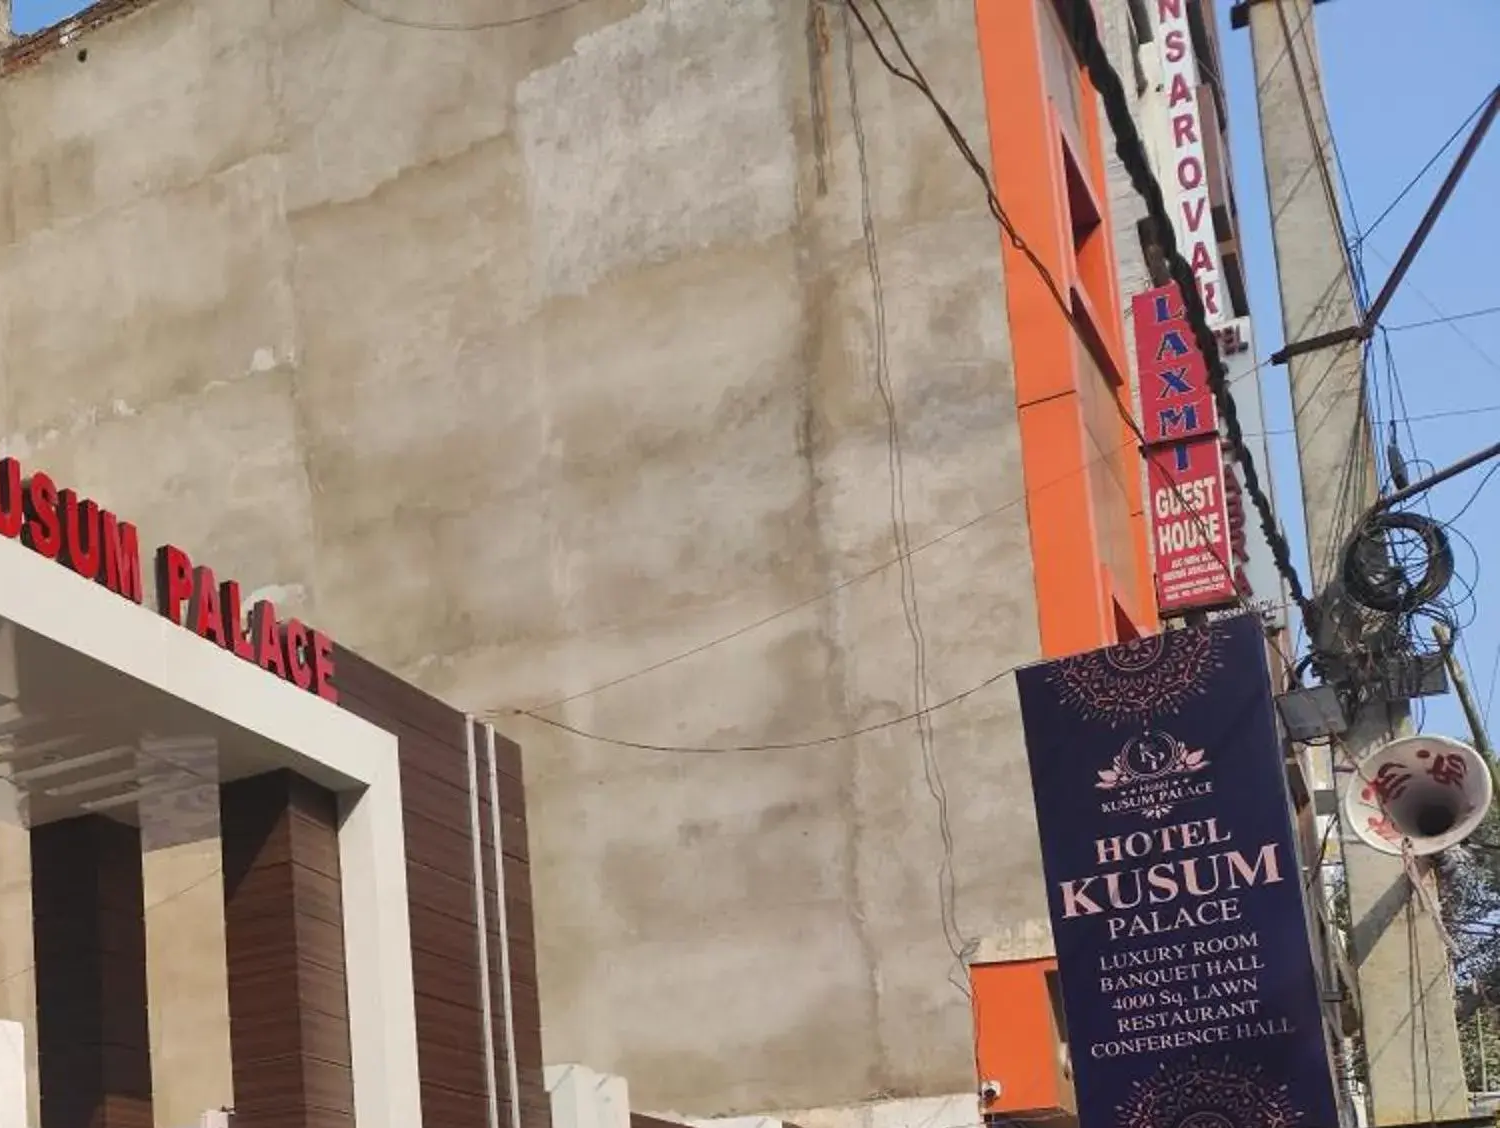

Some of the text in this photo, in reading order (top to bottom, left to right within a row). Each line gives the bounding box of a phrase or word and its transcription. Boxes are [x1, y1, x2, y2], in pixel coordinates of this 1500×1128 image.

[1155, 475, 1216, 519] GUEST
[1158, 512, 1222, 556] HOUSE
[156, 543, 342, 704] PALACE
[1100, 781, 1213, 814] KUSUM PALACE
[1095, 817, 1231, 865] HOTEL
[1058, 843, 1284, 921] KUSUM
[1107, 898, 1242, 940] PALACE
[1100, 931, 1259, 971] LUXURY ROOM
[1100, 953, 1265, 992] BANQUET HALL
[1111, 989, 1155, 1011] 4000
[1192, 977, 1258, 1001] LAWN
[1090, 1016, 1295, 1059] CONFERENCE HALL
[1117, 1000, 1260, 1034] RESTAURANT
